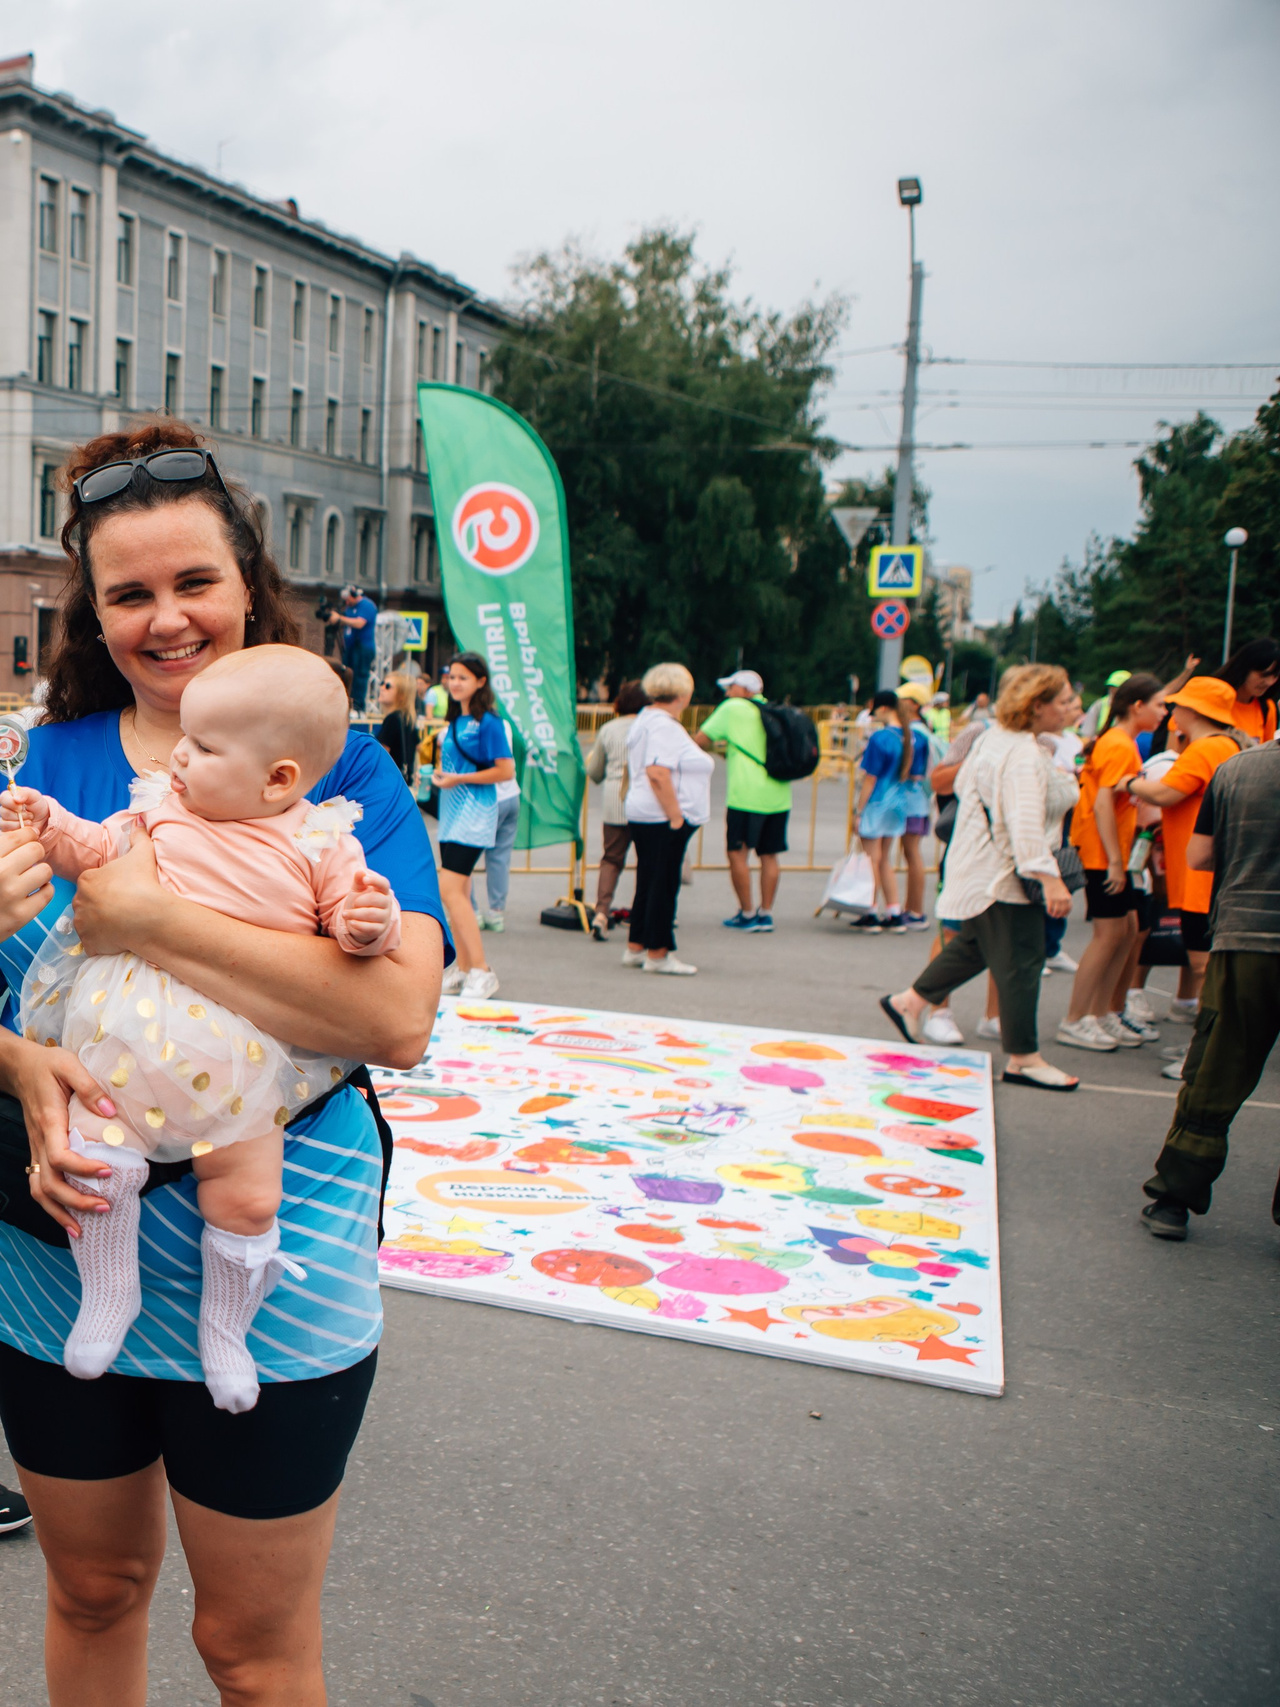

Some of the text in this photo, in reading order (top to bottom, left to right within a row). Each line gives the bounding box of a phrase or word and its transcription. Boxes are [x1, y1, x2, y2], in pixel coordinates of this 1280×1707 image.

[449, 1183, 548, 1193] Держим
[453, 1191, 609, 1202] низкие цены
